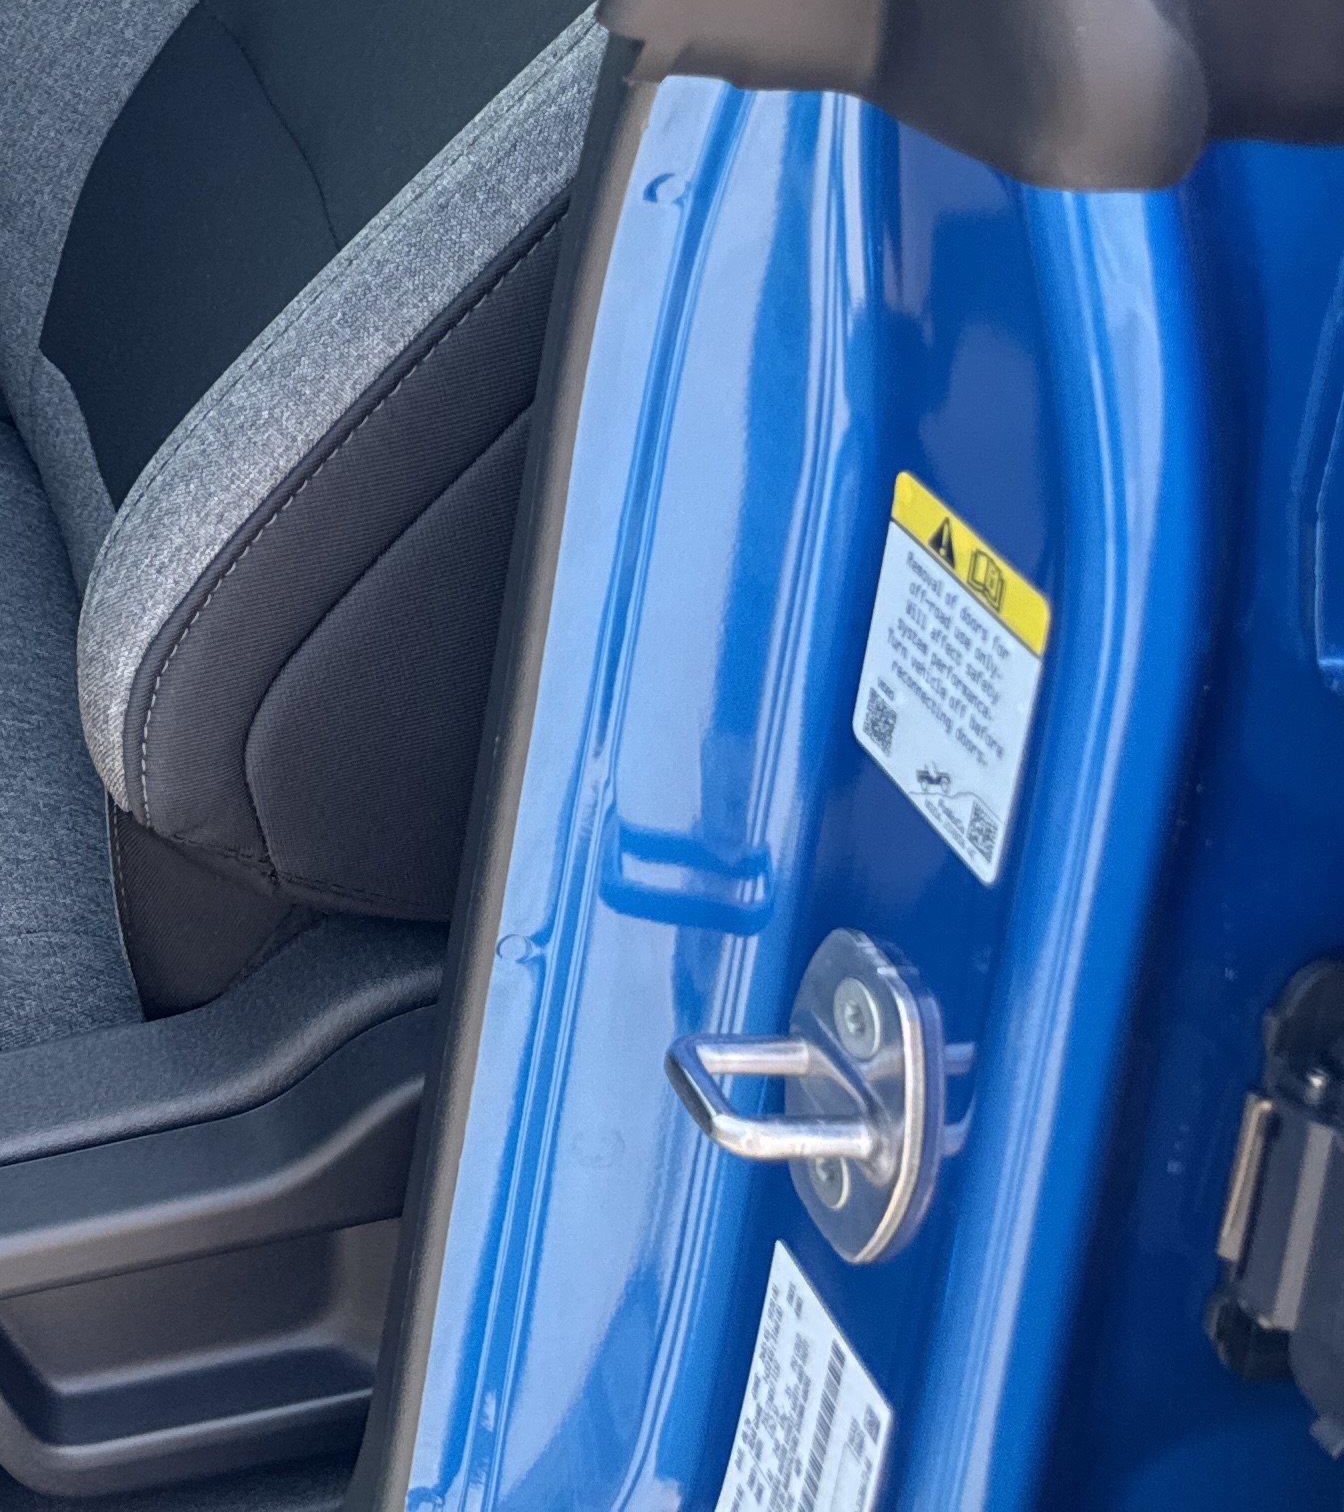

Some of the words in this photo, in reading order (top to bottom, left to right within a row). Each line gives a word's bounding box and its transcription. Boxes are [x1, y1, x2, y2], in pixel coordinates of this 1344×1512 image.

[896, 616, 928, 659] system
[904, 598, 927, 631] Will
[929, 623, 962, 667] affect
[964, 659, 1001, 708] safety
[905, 550, 943, 598] Removal
[944, 587, 958, 612] of
[959, 603, 989, 642] doors
[991, 634, 1011, 663] for
[908, 578, 951, 631] off-road
[953, 624, 971, 651] use
[886, 627, 907, 660] Turn
[910, 653, 947, 701] vehicle
[948, 692, 967, 722] off
[968, 713, 1004, 760] before
[890, 658, 954, 735] reconnecting
